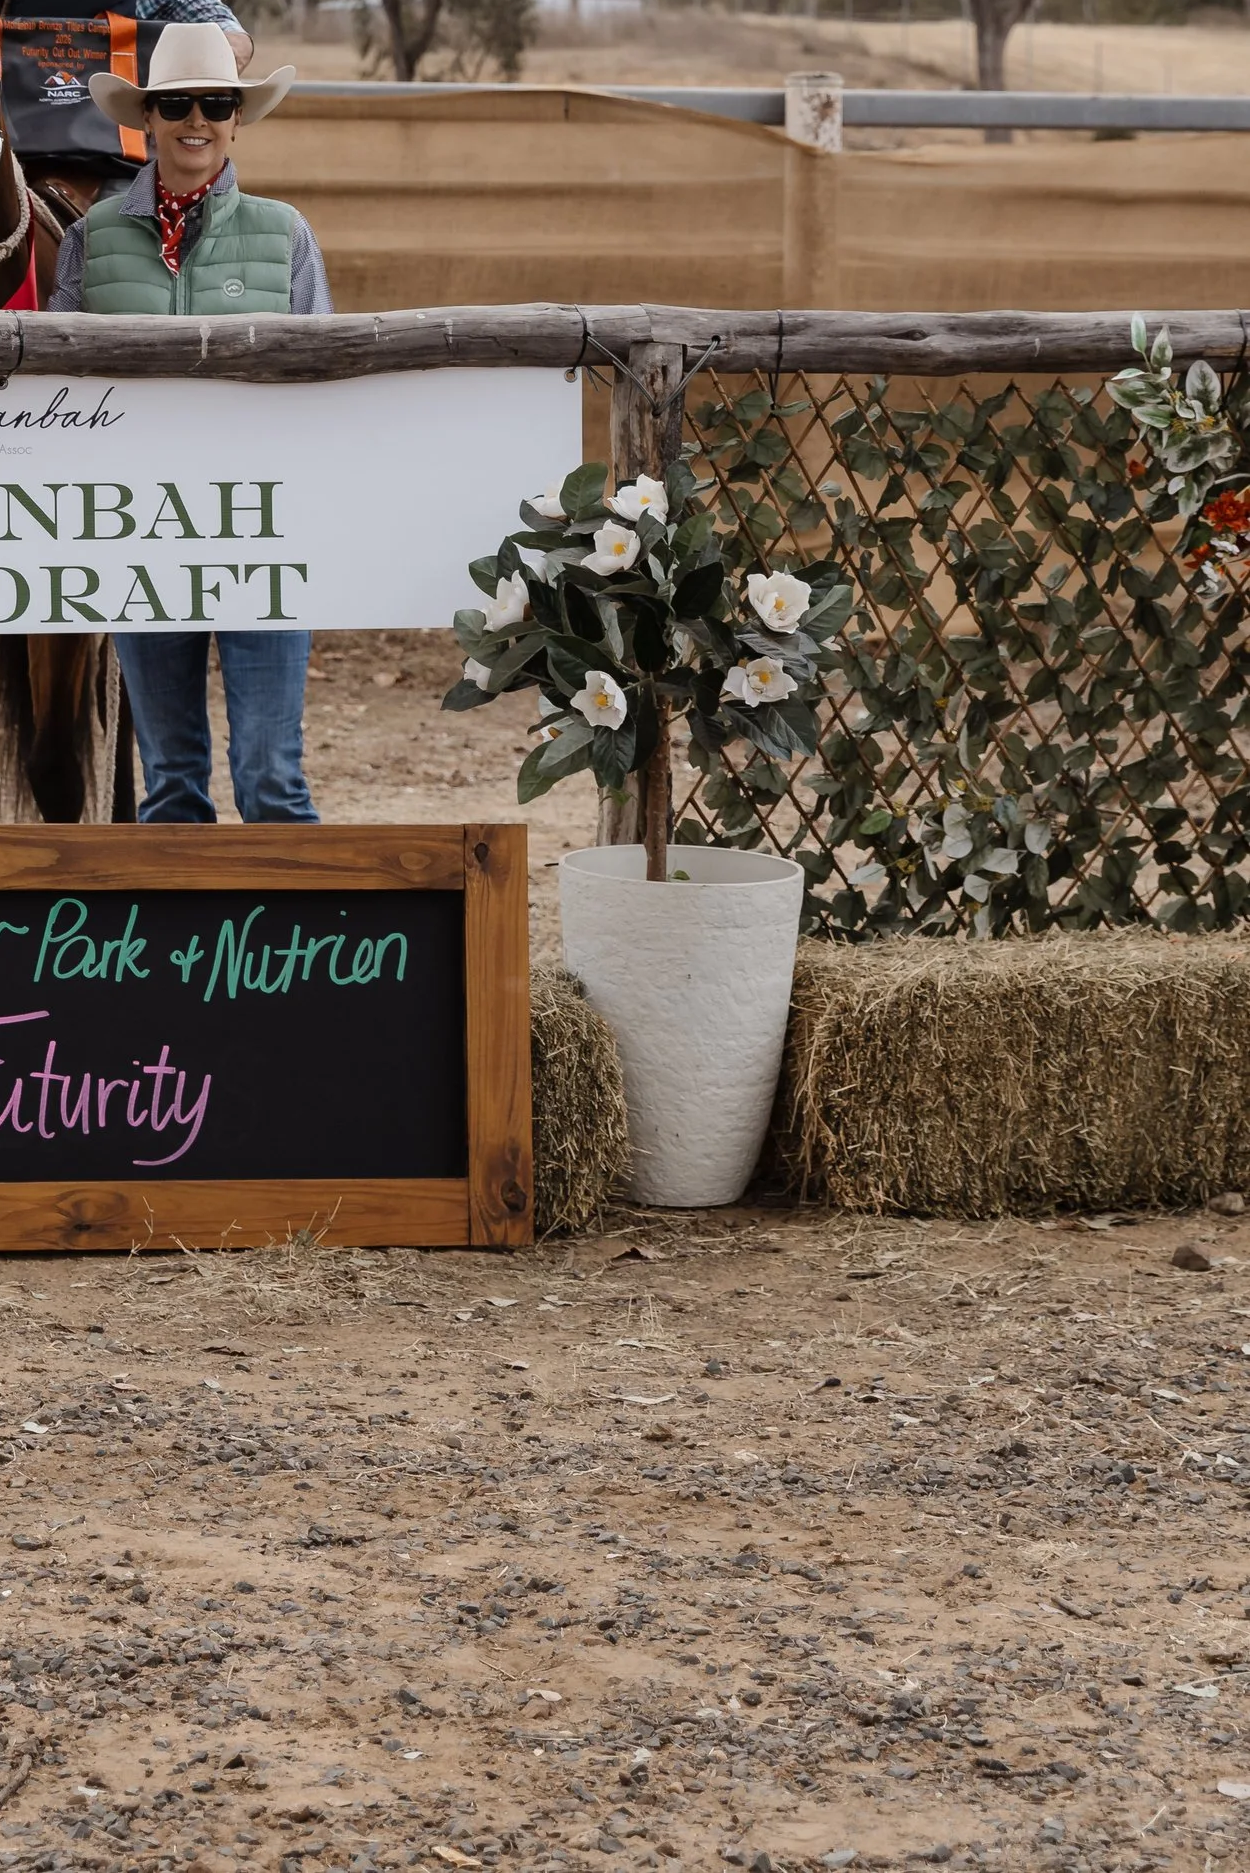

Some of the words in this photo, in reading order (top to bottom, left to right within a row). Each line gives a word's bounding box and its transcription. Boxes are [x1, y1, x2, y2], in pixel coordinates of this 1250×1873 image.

[39, 21, 63, 30] Bronze
[22, 47, 49, 58] Futurity
[53, 47, 66, 58] Cut
[68, 48, 81, 58] Out
[83, 49, 107, 60] Winner
[76, 62, 85, 70] by
[47, 90, 81, 98] NARC
[34, 898, 149, 982] Park
[204, 906, 407, 1002] Nutrien
